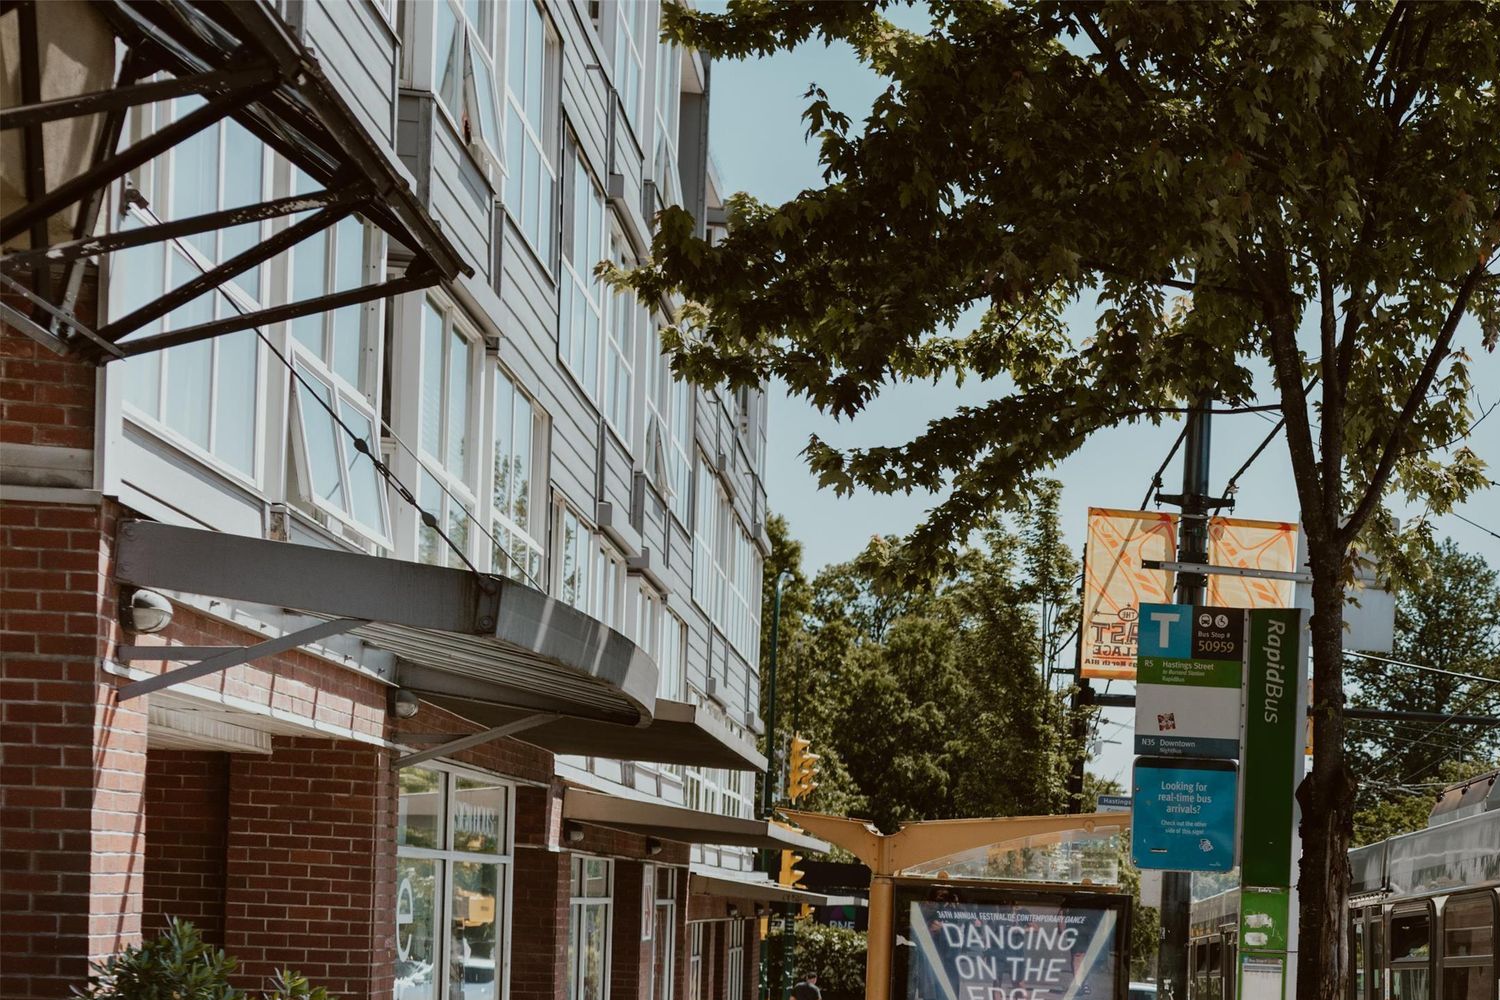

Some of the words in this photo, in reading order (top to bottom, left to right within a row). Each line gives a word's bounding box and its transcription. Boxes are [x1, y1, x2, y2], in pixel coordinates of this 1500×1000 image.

[1151, 612, 1180, 648] T
[1210, 631, 1226, 639] Stop
[1198, 640, 1235, 653] 50959
[1144, 659, 1154, 668] R5
[1162, 660, 1193, 671] Hastings
[1193, 662, 1215, 671] Street
[1262, 619, 1286, 724] RapidBus
[1141, 738, 1156, 746] N35
[1160, 739, 1196, 748] Downtown
[1161, 781, 1194, 793] Looking
[1195, 782, 1208, 792] for
[1158, 793, 1195, 803] real-time
[1196, 794, 1212, 804] bus
[1166, 804, 1201, 814] arrivals?
[953, 911, 978, 920] ANNUAL
[978, 912, 1006, 921] FESTIVAL
[1016, 914, 1065, 924] CONTEMPORARY
[1065, 915, 1087, 924] DANCE
[943, 922, 1079, 951] DANCING
[955, 954, 997, 980] ON
[1006, 956, 1066, 982] THE
